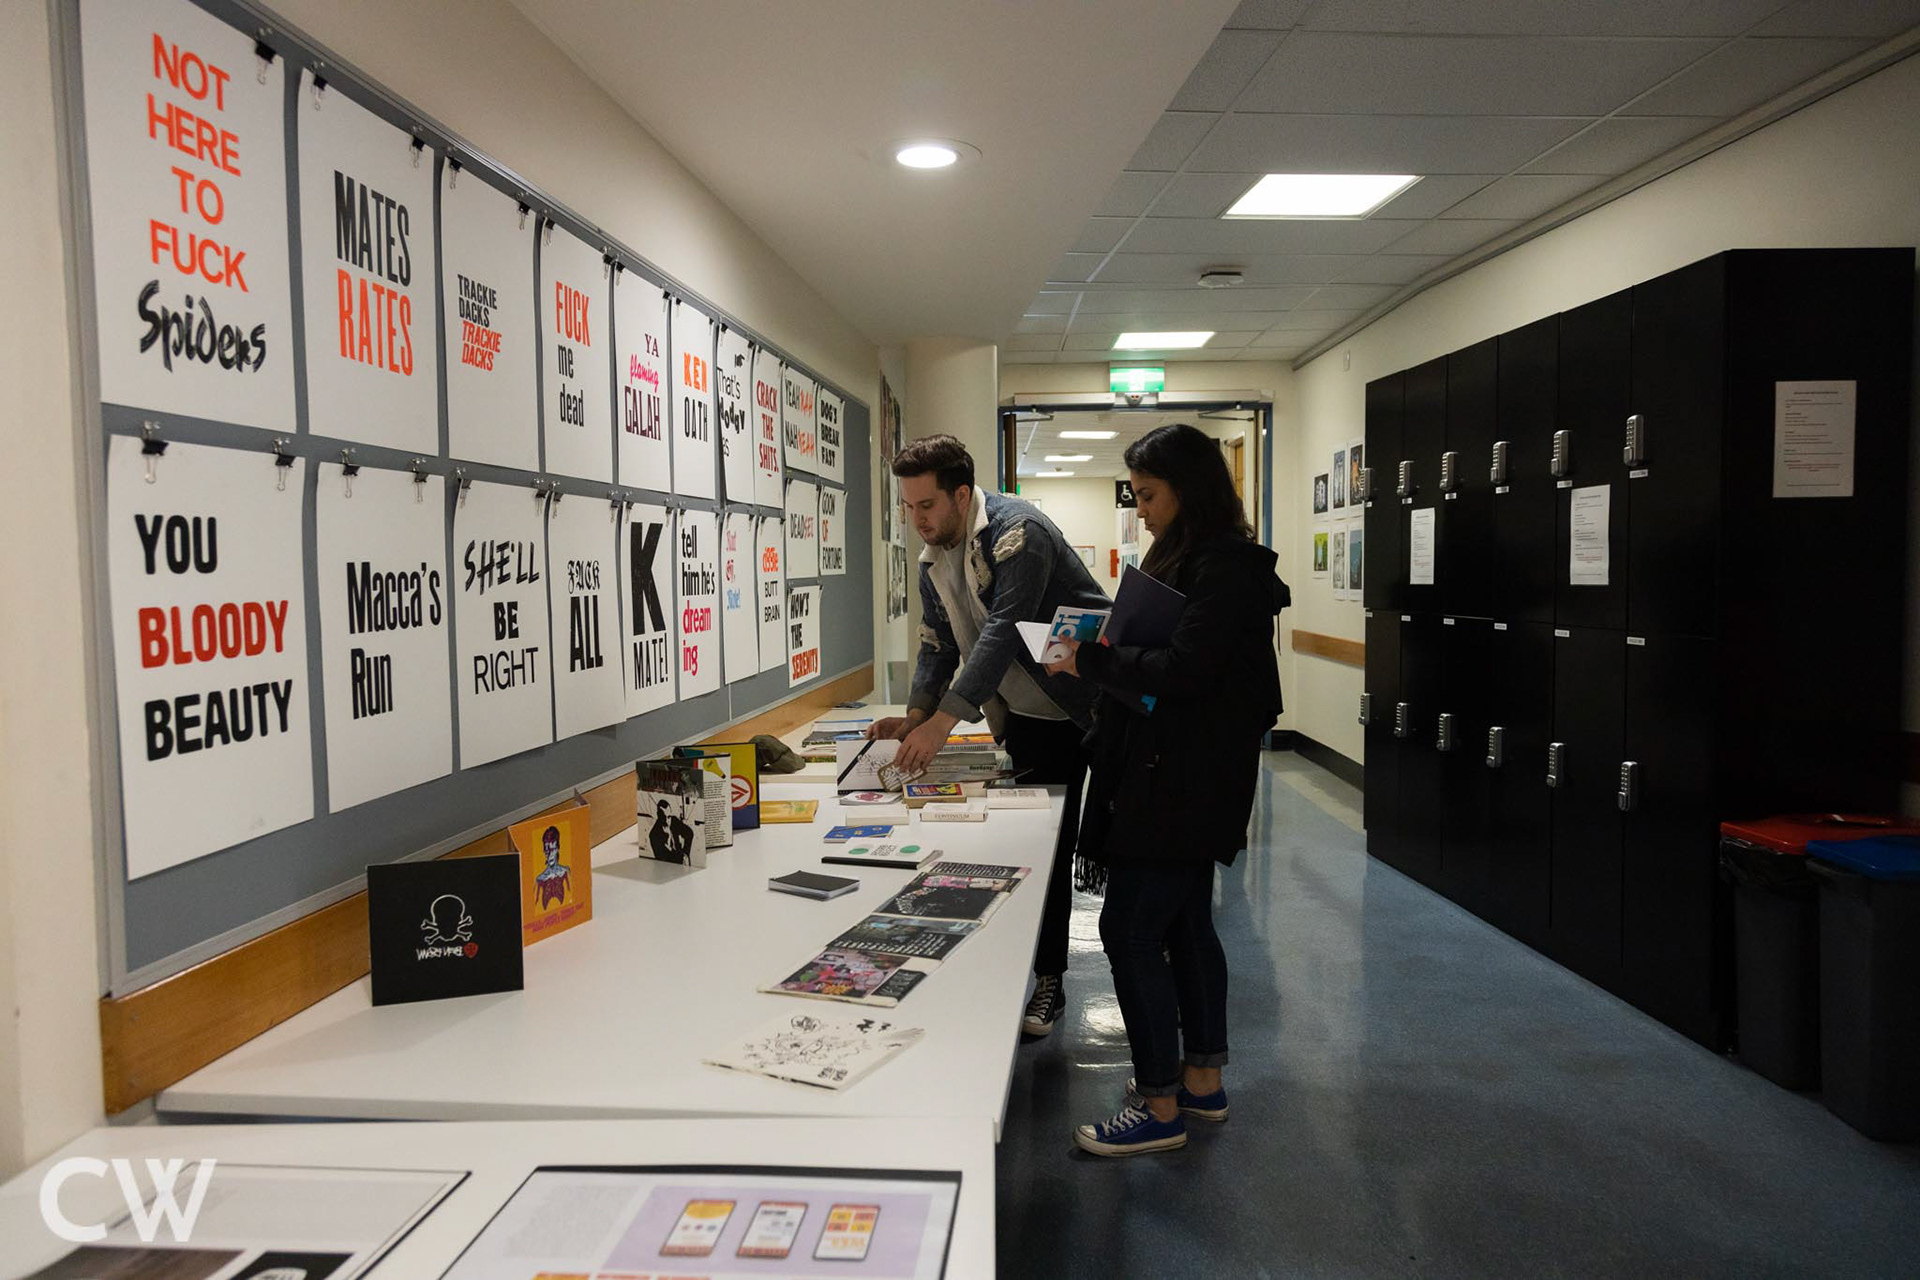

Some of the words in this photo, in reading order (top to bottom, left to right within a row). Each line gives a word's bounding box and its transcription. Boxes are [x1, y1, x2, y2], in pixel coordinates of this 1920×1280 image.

[152, 33, 230, 111] NOT
[146, 93, 241, 177] HERE
[171, 166, 224, 225] TO
[334, 170, 411, 287] MATES
[150, 219, 249, 293] FUCK
[457, 274, 498, 310] TRACKIE
[137, 279, 266, 373] Spiders
[337, 268, 413, 376] RATES
[459, 297, 490, 328] DACKS
[555, 281, 591, 347] FUCK
[462, 320, 502, 353] TRACKIE
[644, 333, 660, 358] YA
[461, 342, 494, 372] DACKS
[558, 344, 574, 379] me
[630, 353, 659, 393] flaming
[683, 352, 707, 393] KEN
[559, 383, 585, 427] dead
[624, 385, 661, 441] GALAH
[756, 380, 778, 413] CRACK
[820, 399, 838, 424] DOG'S
[684, 396, 708, 442] OATH
[762, 413, 774, 441] THE
[820, 423, 840, 448] BREAK
[821, 445, 836, 468] FAST
[134, 514, 218, 575] YOU
[682, 525, 698, 558] tell
[822, 519, 829, 542] OF
[464, 539, 540, 597] SHE'LL
[630, 521, 667, 637] K
[682, 562, 700, 596] him
[701, 564, 715, 596] he's
[346, 562, 442, 634] Macca's
[764, 580, 778, 598] BUTT
[791, 593, 810, 620] HOW'S
[493, 601, 519, 641] BE
[570, 594, 603, 672] ALL
[683, 600, 712, 634] dream
[764, 604, 781, 623] BRAIN
[138, 600, 289, 669] BLOODY
[791, 623, 803, 650] THE
[473, 647, 539, 695] RIGHT
[633, 632, 669, 690] MATE!
[683, 640, 698, 676] ing
[351, 648, 394, 719] Run
[144, 679, 293, 761] BEAUTY
